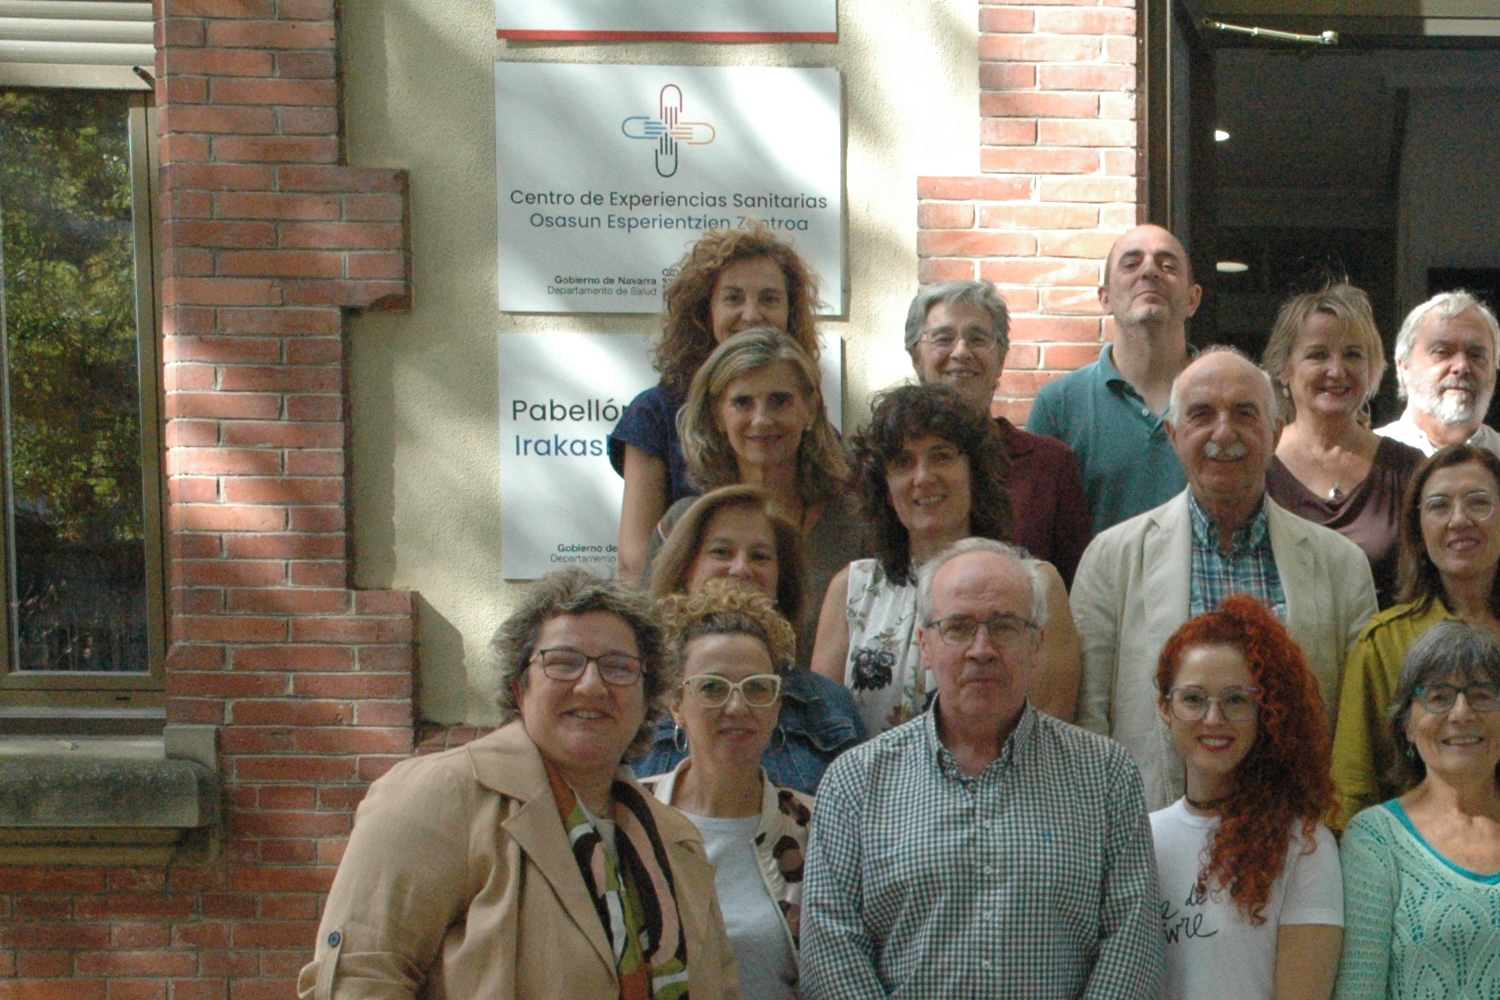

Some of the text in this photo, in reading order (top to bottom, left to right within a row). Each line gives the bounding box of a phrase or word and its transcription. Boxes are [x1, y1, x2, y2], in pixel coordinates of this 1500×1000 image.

[510, 189, 828, 211] Centro de Experiencias Sanitarias
[530, 212, 809, 233] Osasun Esperientzien Zntroa
[554, 275, 657, 285] Gobierno de Navarra
[547, 285, 657, 296] Departamento de Salud
[557, 543, 618, 552] Gobierno de
